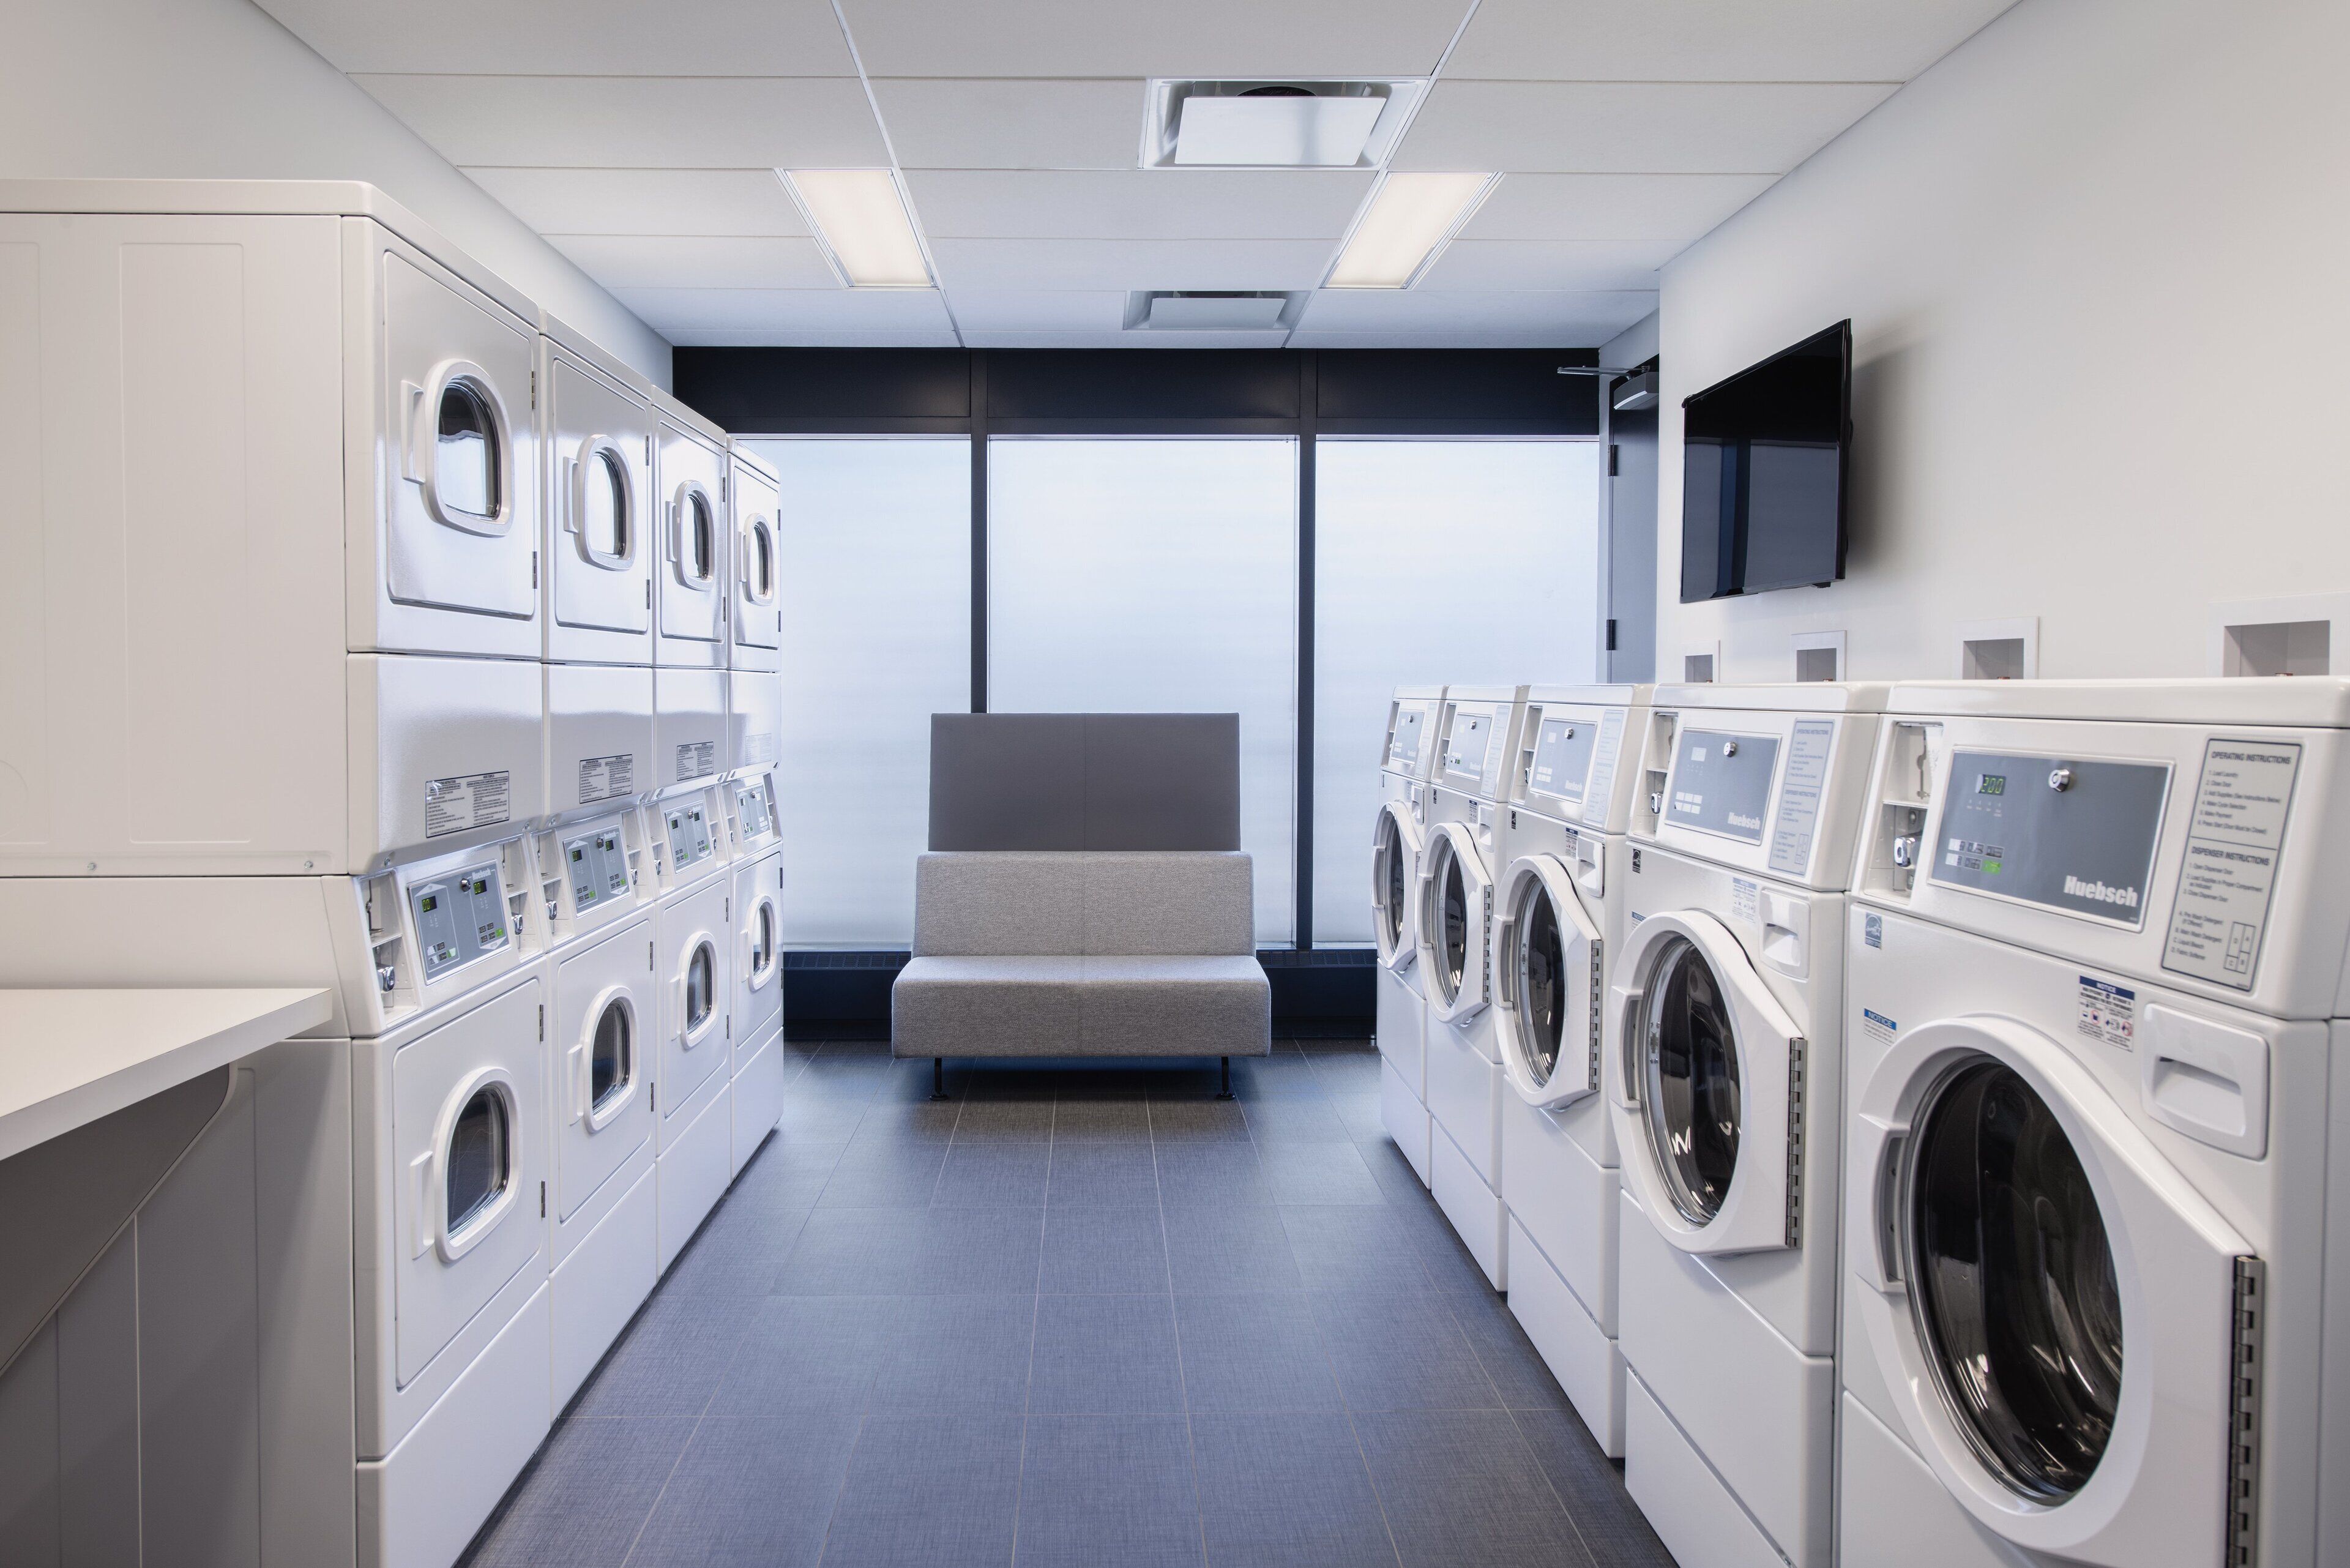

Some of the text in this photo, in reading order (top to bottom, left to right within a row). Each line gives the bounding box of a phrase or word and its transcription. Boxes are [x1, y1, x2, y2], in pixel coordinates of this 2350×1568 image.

[2211, 752, 2291, 764] OPERATING INSTRUCTIONS
[1980, 777, 2004, 794] 200
[1728, 812, 1761, 830] Huebsch
[2191, 846, 2270, 865] DISPENSER INSTRUCTIONS
[2064, 875, 2138, 907] Huebsch
[1868, 1011, 1892, 1028] NOTICE
